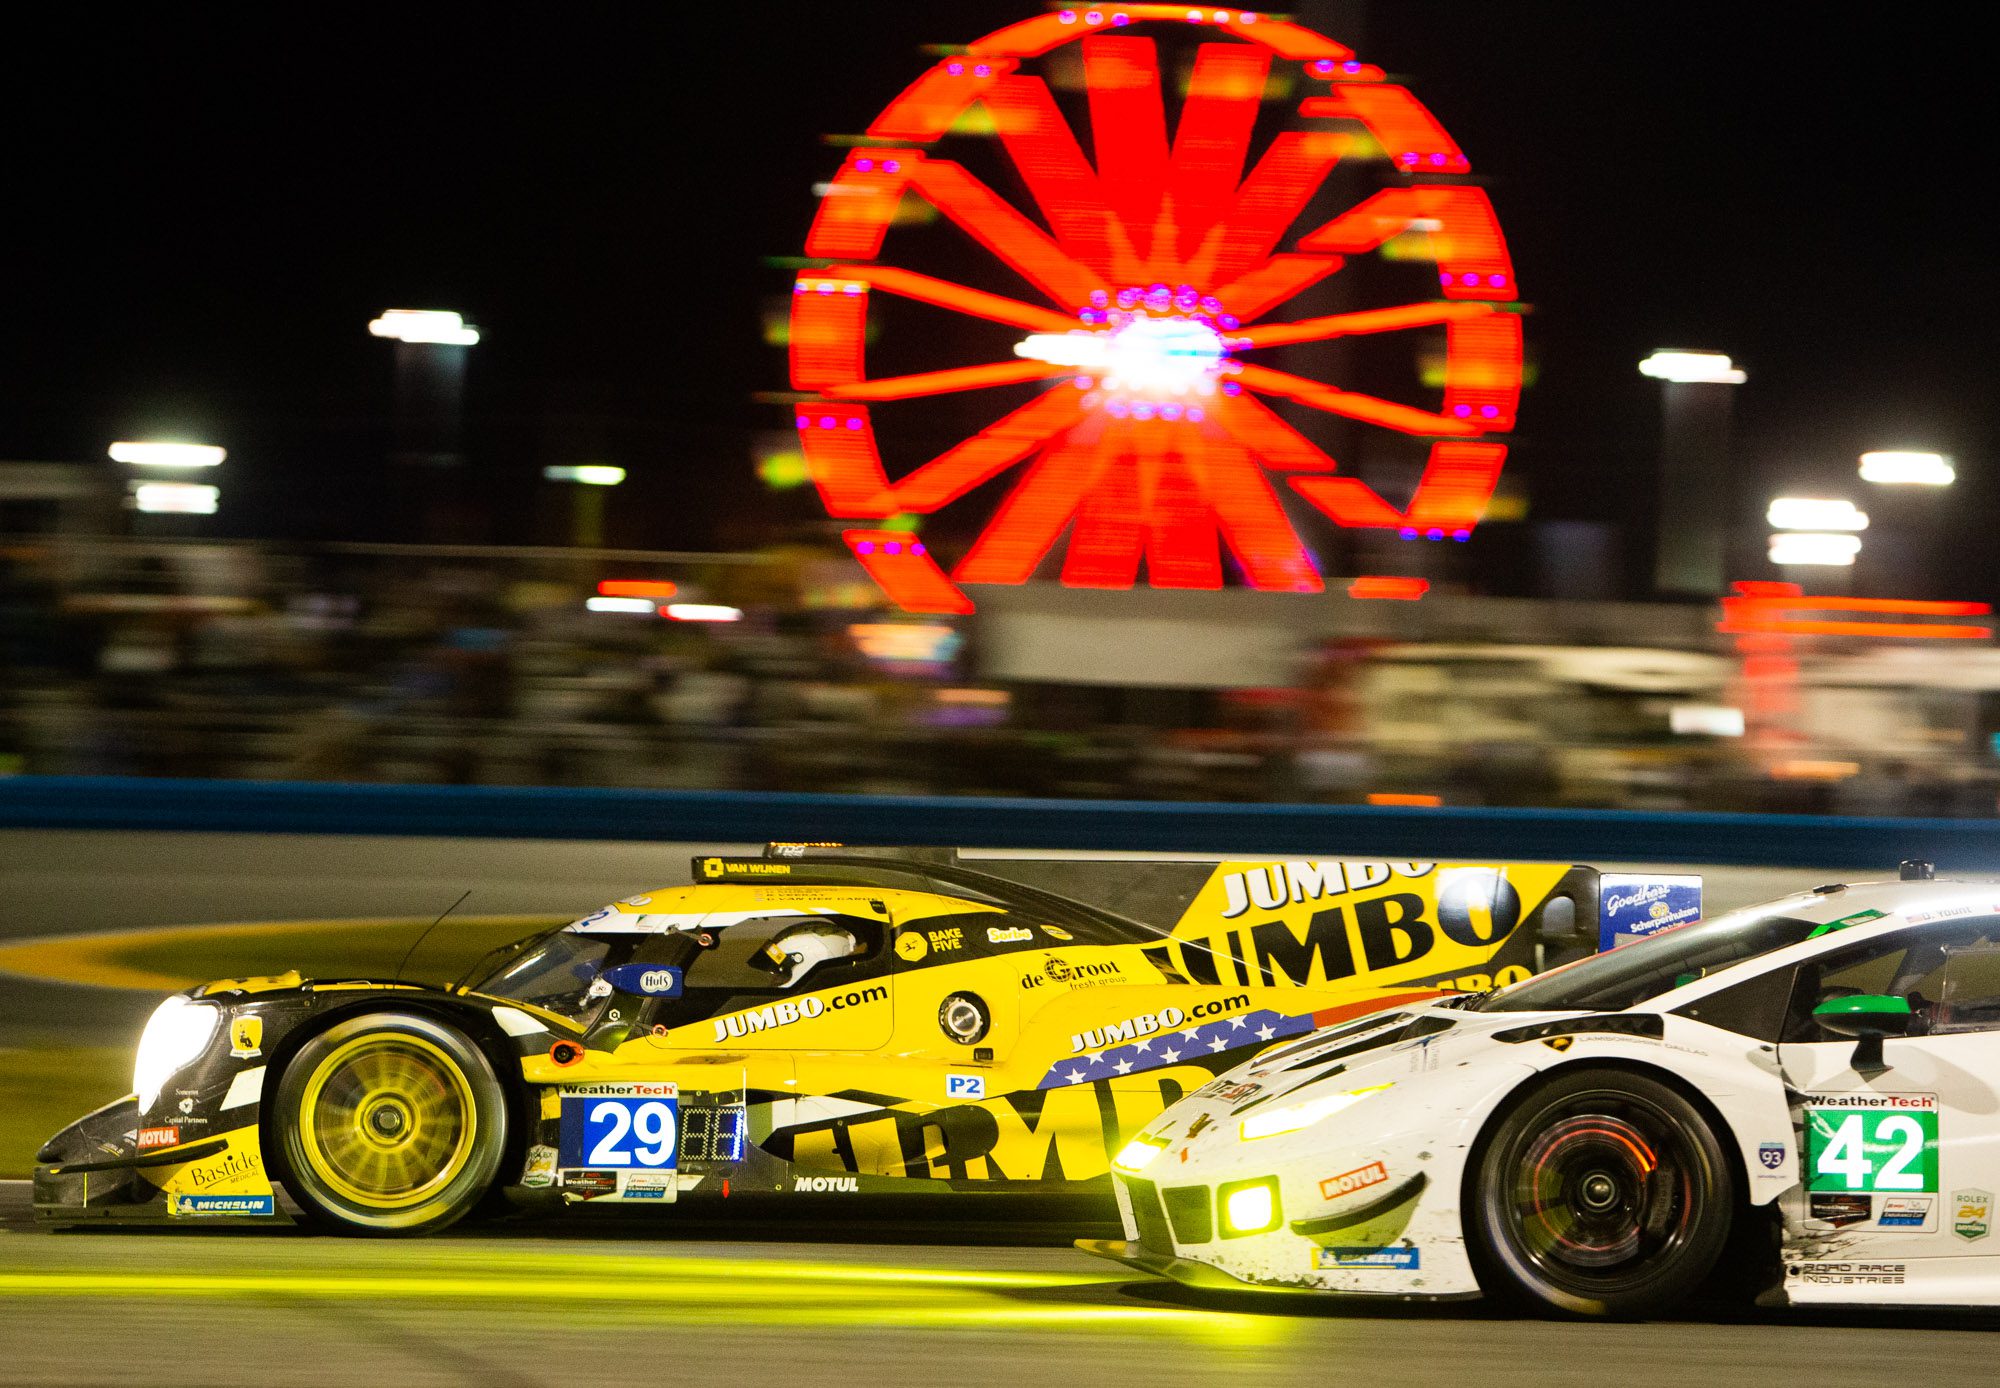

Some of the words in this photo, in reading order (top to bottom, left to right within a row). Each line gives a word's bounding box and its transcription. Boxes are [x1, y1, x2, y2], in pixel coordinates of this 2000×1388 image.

[726, 863, 748, 873] VAN
[750, 864, 791, 874] WIJNEN
[928, 927, 964, 942] BAKE
[932, 938, 963, 952] FIVE
[645, 975, 669, 987] Huls
[1069, 978, 1096, 992] fresh
[1100, 974, 1128, 988] group
[713, 985, 888, 1043] JUMBO.com
[1071, 994, 1250, 1054] JUMBO.com
[562, 1085, 674, 1096] WeatherTech
[949, 1077, 981, 1095] P2
[1810, 1095, 1934, 1108] WeatherTech
[184, 1116, 208, 1124] Partners
[588, 1101, 677, 1166] 29
[1817, 1114, 1925, 1190] 42
[191, 1151, 259, 1186] Bastide
[794, 1176, 859, 1193] MOTUL
[1324, 1165, 1385, 1197] MOTUL
[196, 1201, 265, 1210] MICHELIN
[1956, 1195, 1989, 1204] ROLEX
[1957, 1205, 1986, 1219] 24
[1803, 1263, 1852, 1273] ROAD
[1857, 1263, 1906, 1273] RACE
[1803, 1275, 1905, 1285] INDUSTRIES
